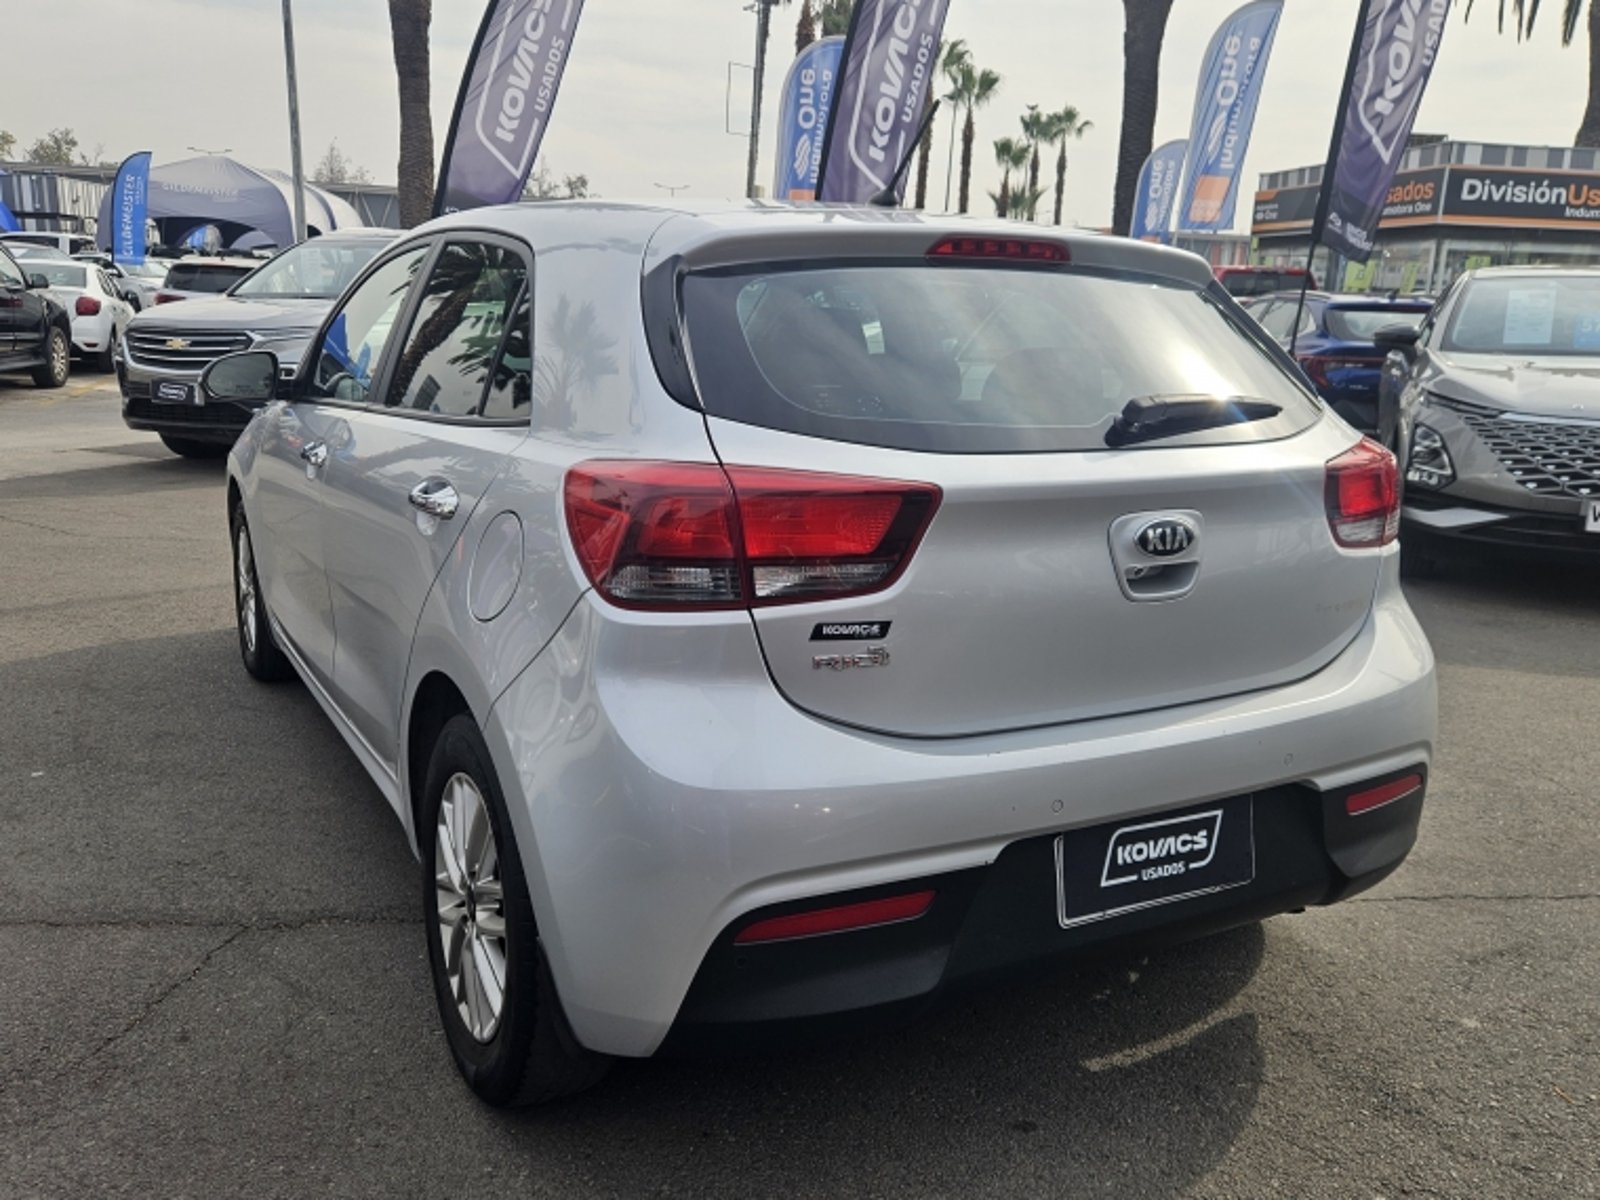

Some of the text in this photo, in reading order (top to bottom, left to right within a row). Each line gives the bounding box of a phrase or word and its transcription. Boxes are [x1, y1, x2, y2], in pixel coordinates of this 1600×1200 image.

[534, 35, 565, 113] USADOS
[868, 0, 920, 163] KOVAC
[902, 32, 933, 124] USADOS
[1147, 526, 1188, 551] KIA
[1117, 829, 1208, 865] KOVACS
[1141, 861, 1186, 880] USADOS
